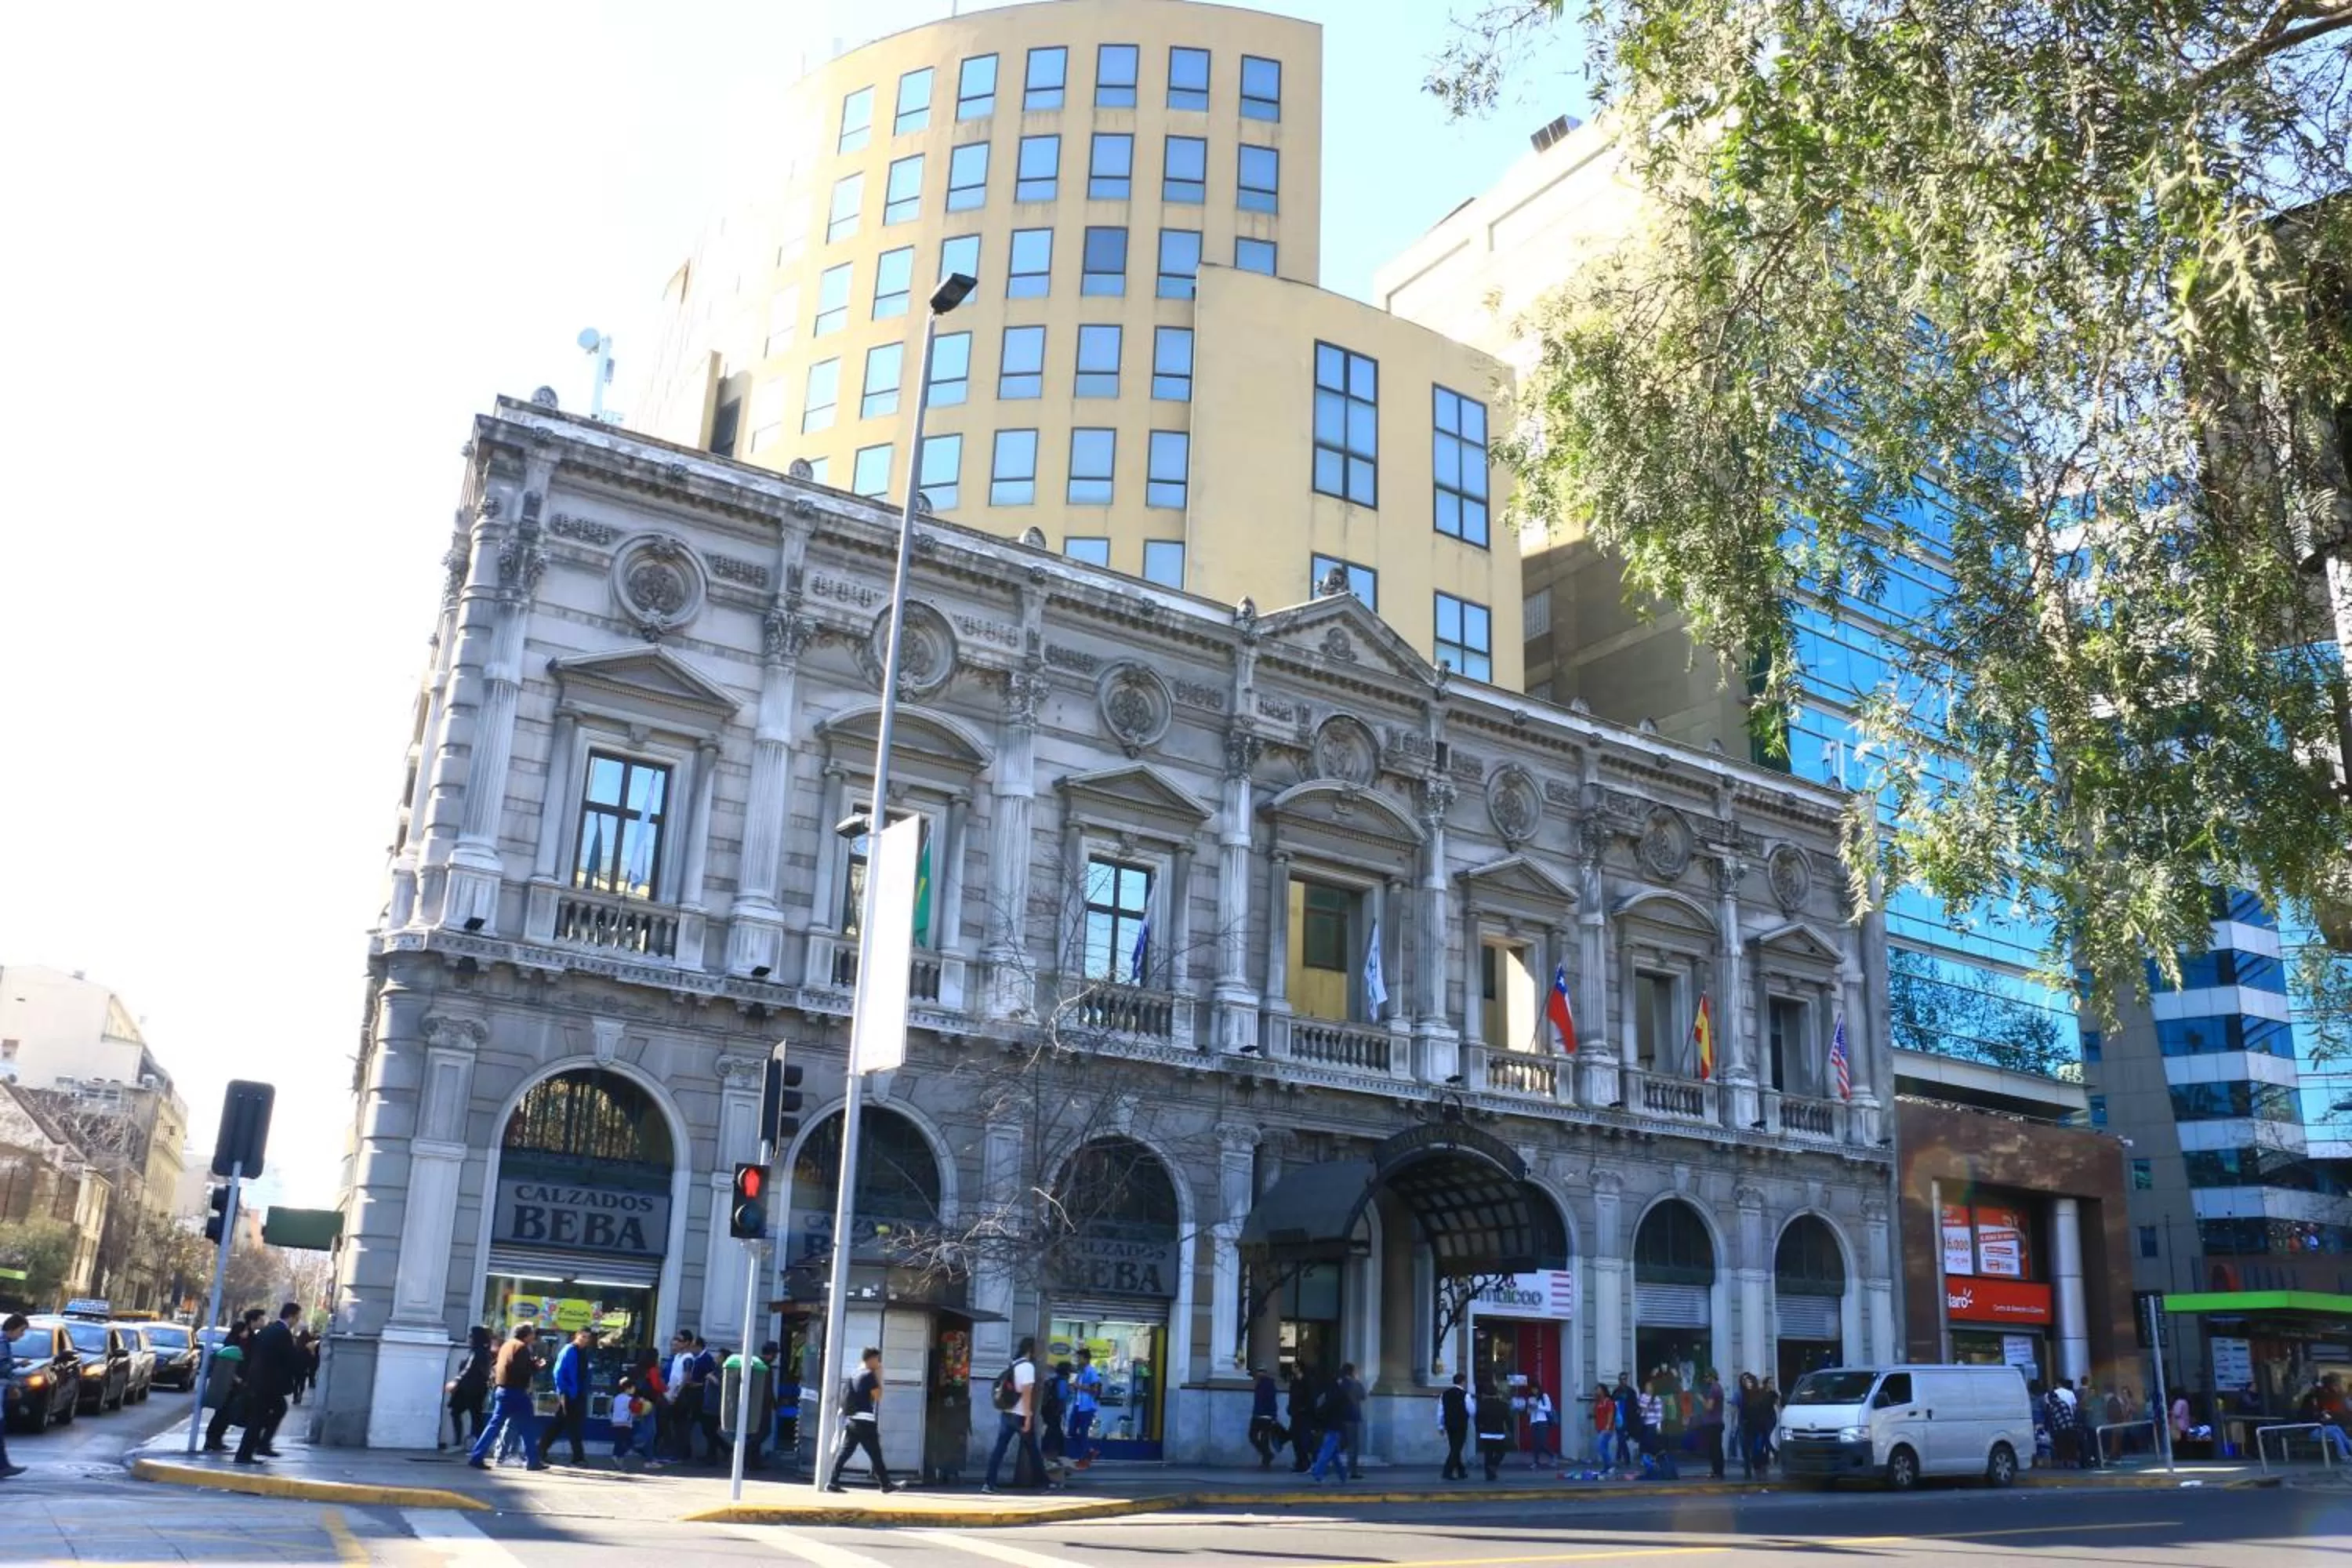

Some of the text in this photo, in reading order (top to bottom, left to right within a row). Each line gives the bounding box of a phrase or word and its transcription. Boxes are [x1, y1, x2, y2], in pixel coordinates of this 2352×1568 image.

[514, 1185, 653, 1212] CALZADOS
[511, 1204, 647, 1250] BEBA
[1947, 1292, 1969, 1308] laro
